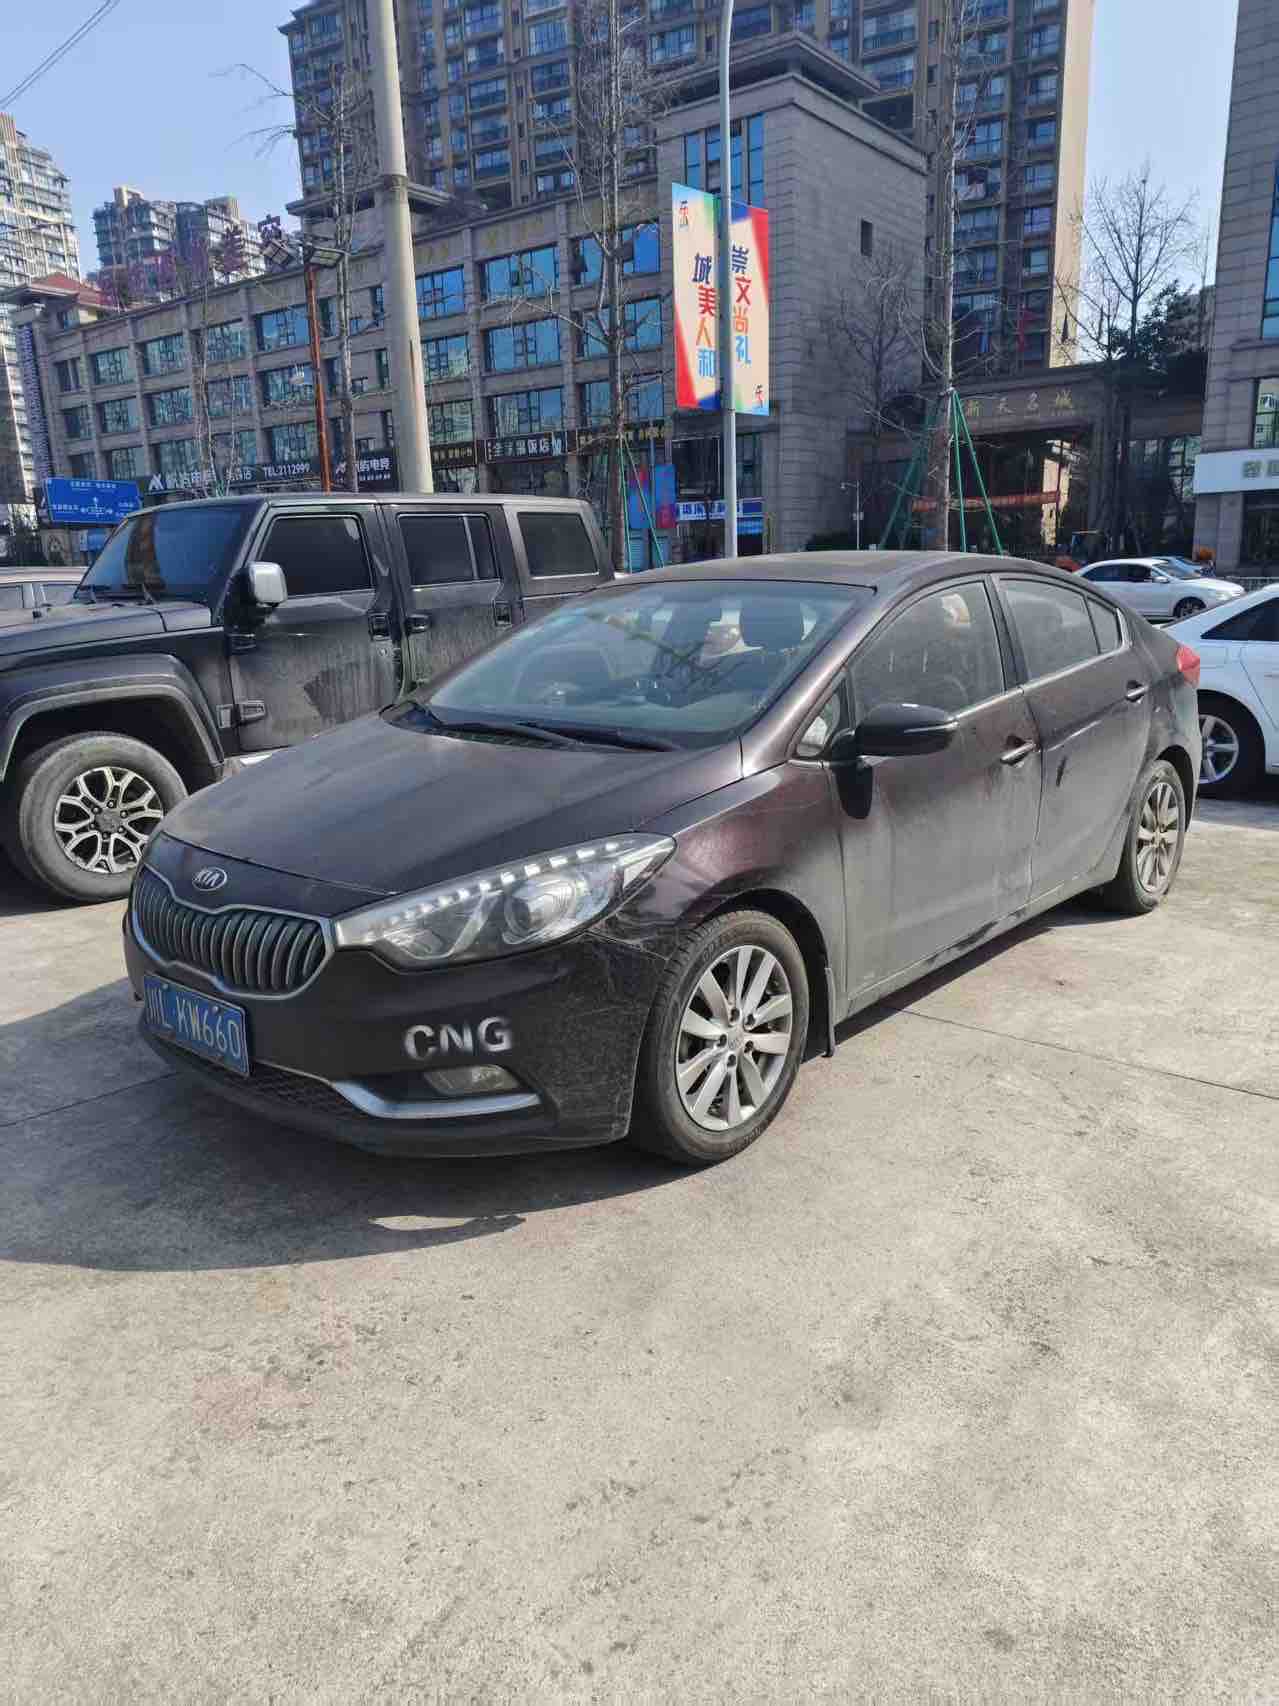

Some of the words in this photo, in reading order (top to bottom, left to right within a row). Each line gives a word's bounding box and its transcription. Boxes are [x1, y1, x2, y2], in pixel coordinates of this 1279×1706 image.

[692, 252, 716, 377] 城美人和
[731, 242, 752, 365] 崇文尚礼
[405, 1017, 512, 1059] CNG
